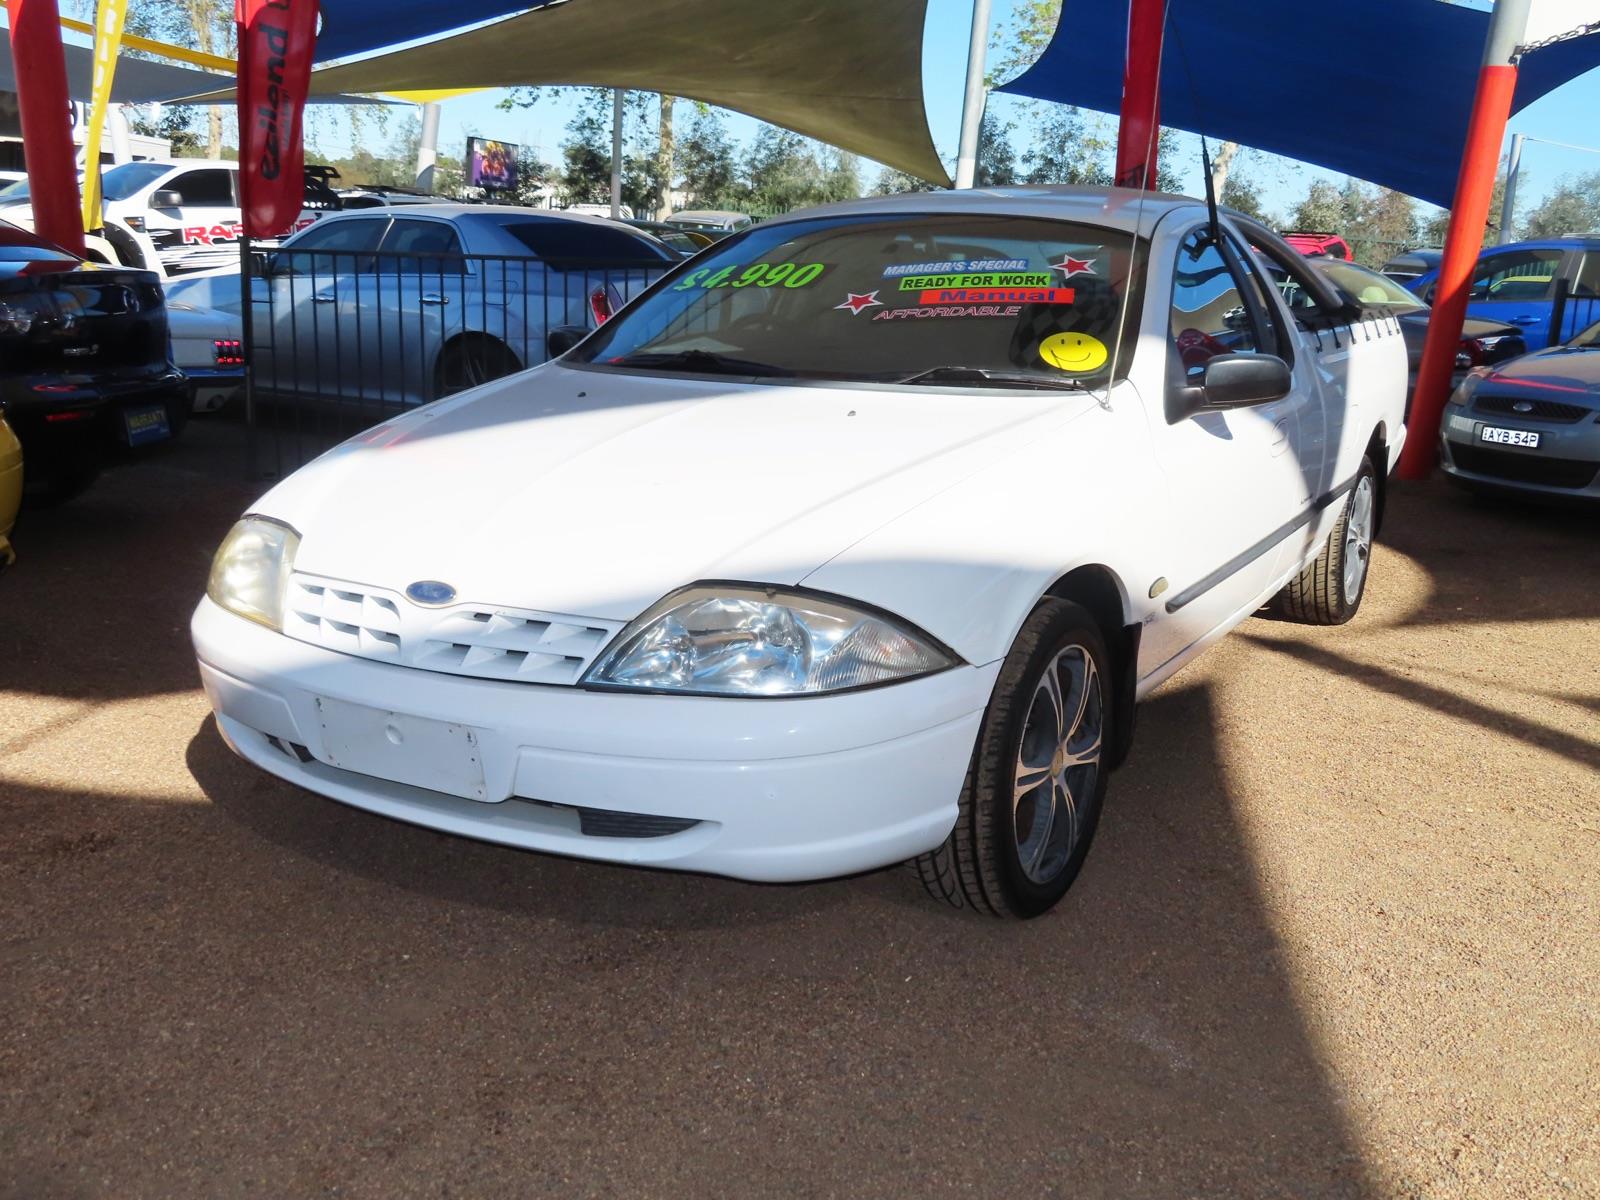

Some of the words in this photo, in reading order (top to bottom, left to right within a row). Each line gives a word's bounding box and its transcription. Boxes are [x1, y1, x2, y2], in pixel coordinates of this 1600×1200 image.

[883, 262, 964, 276] MANAGER'S
[968, 260, 1026, 270] SPECIAL
[902, 277, 956, 289] READY
[961, 276, 993, 287] FOR
[998, 275, 1048, 286] WORK
[940, 290, 1056, 302] Manual
[872, 306, 1022, 320] AFFORDABLE
